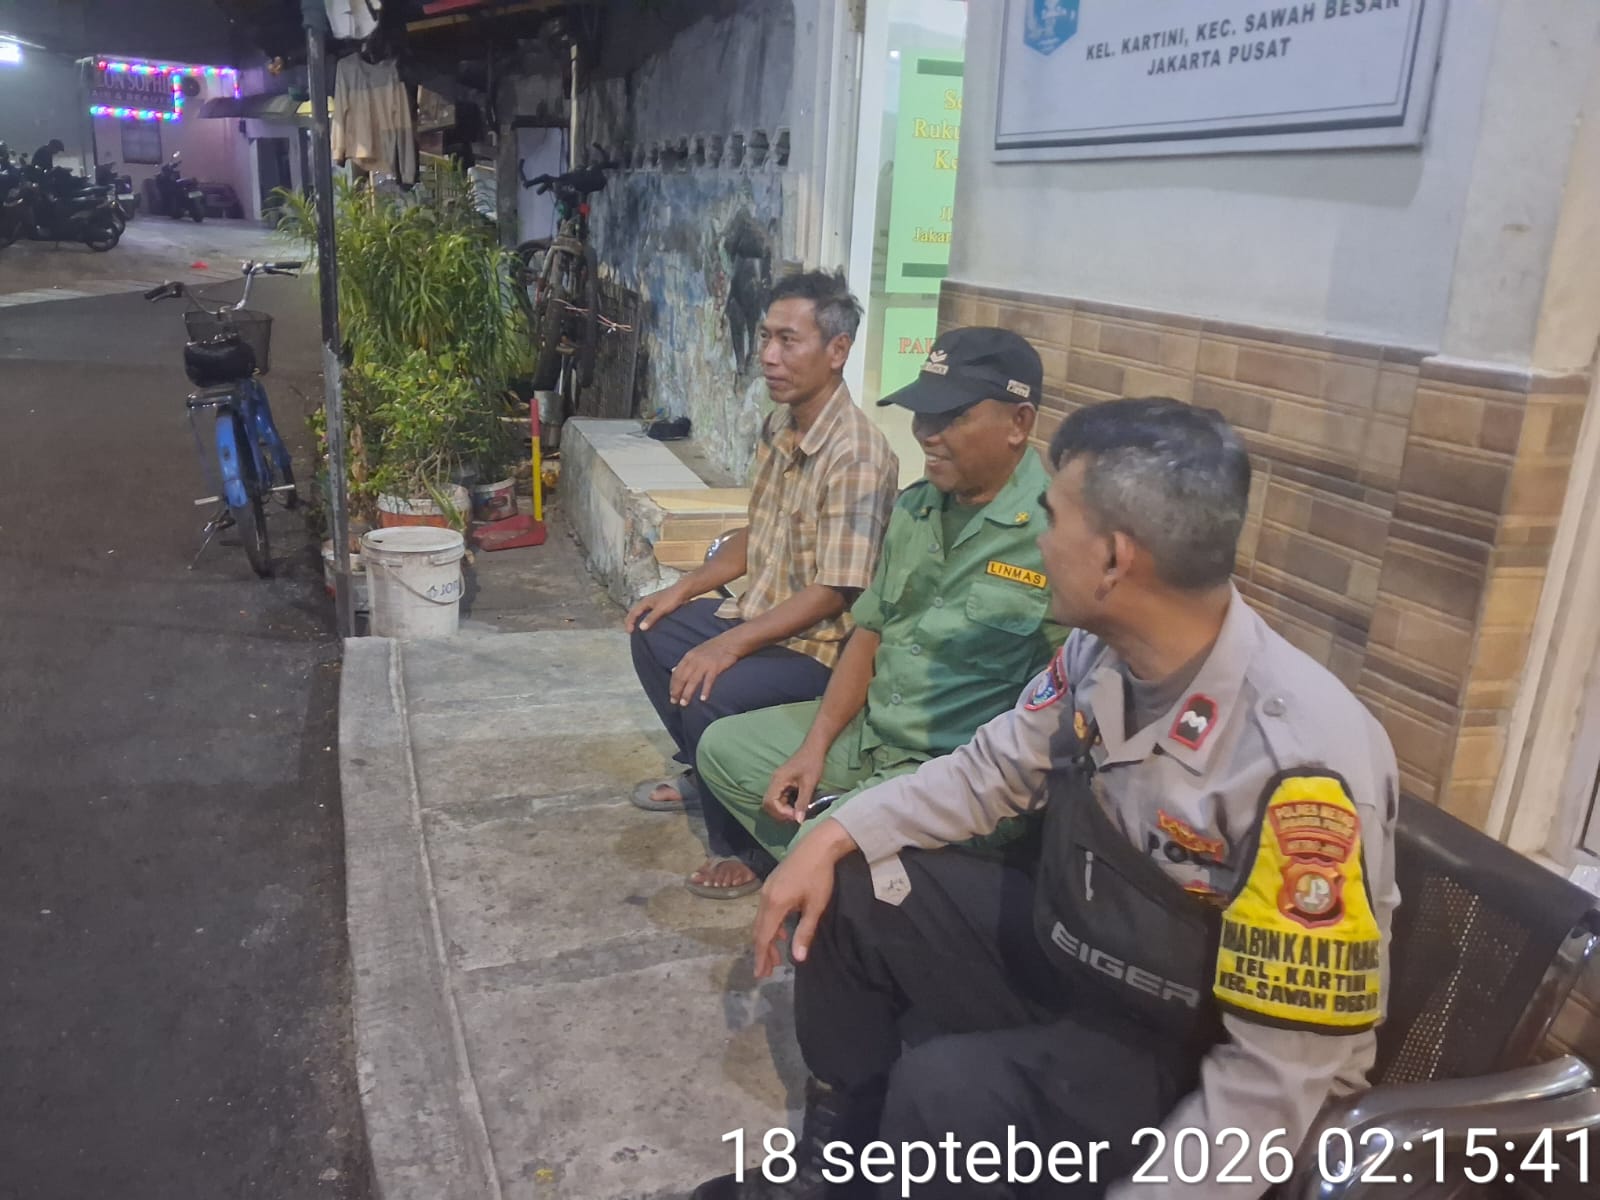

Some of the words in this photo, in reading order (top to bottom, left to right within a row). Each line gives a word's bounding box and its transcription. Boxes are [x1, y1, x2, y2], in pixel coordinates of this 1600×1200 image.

[1086, 42, 1116, 61] KEL.
[1121, 28, 1189, 55] KARTINI,
[1195, 19, 1236, 43] KEC.
[1244, 2, 1315, 33] SAWAH
[1147, 48, 1221, 76] JAKARTA
[1228, 37, 1291, 65] PUSAT
[990, 562, 1042, 585] LINMAS
[1051, 921, 1200, 1007] EIGER
